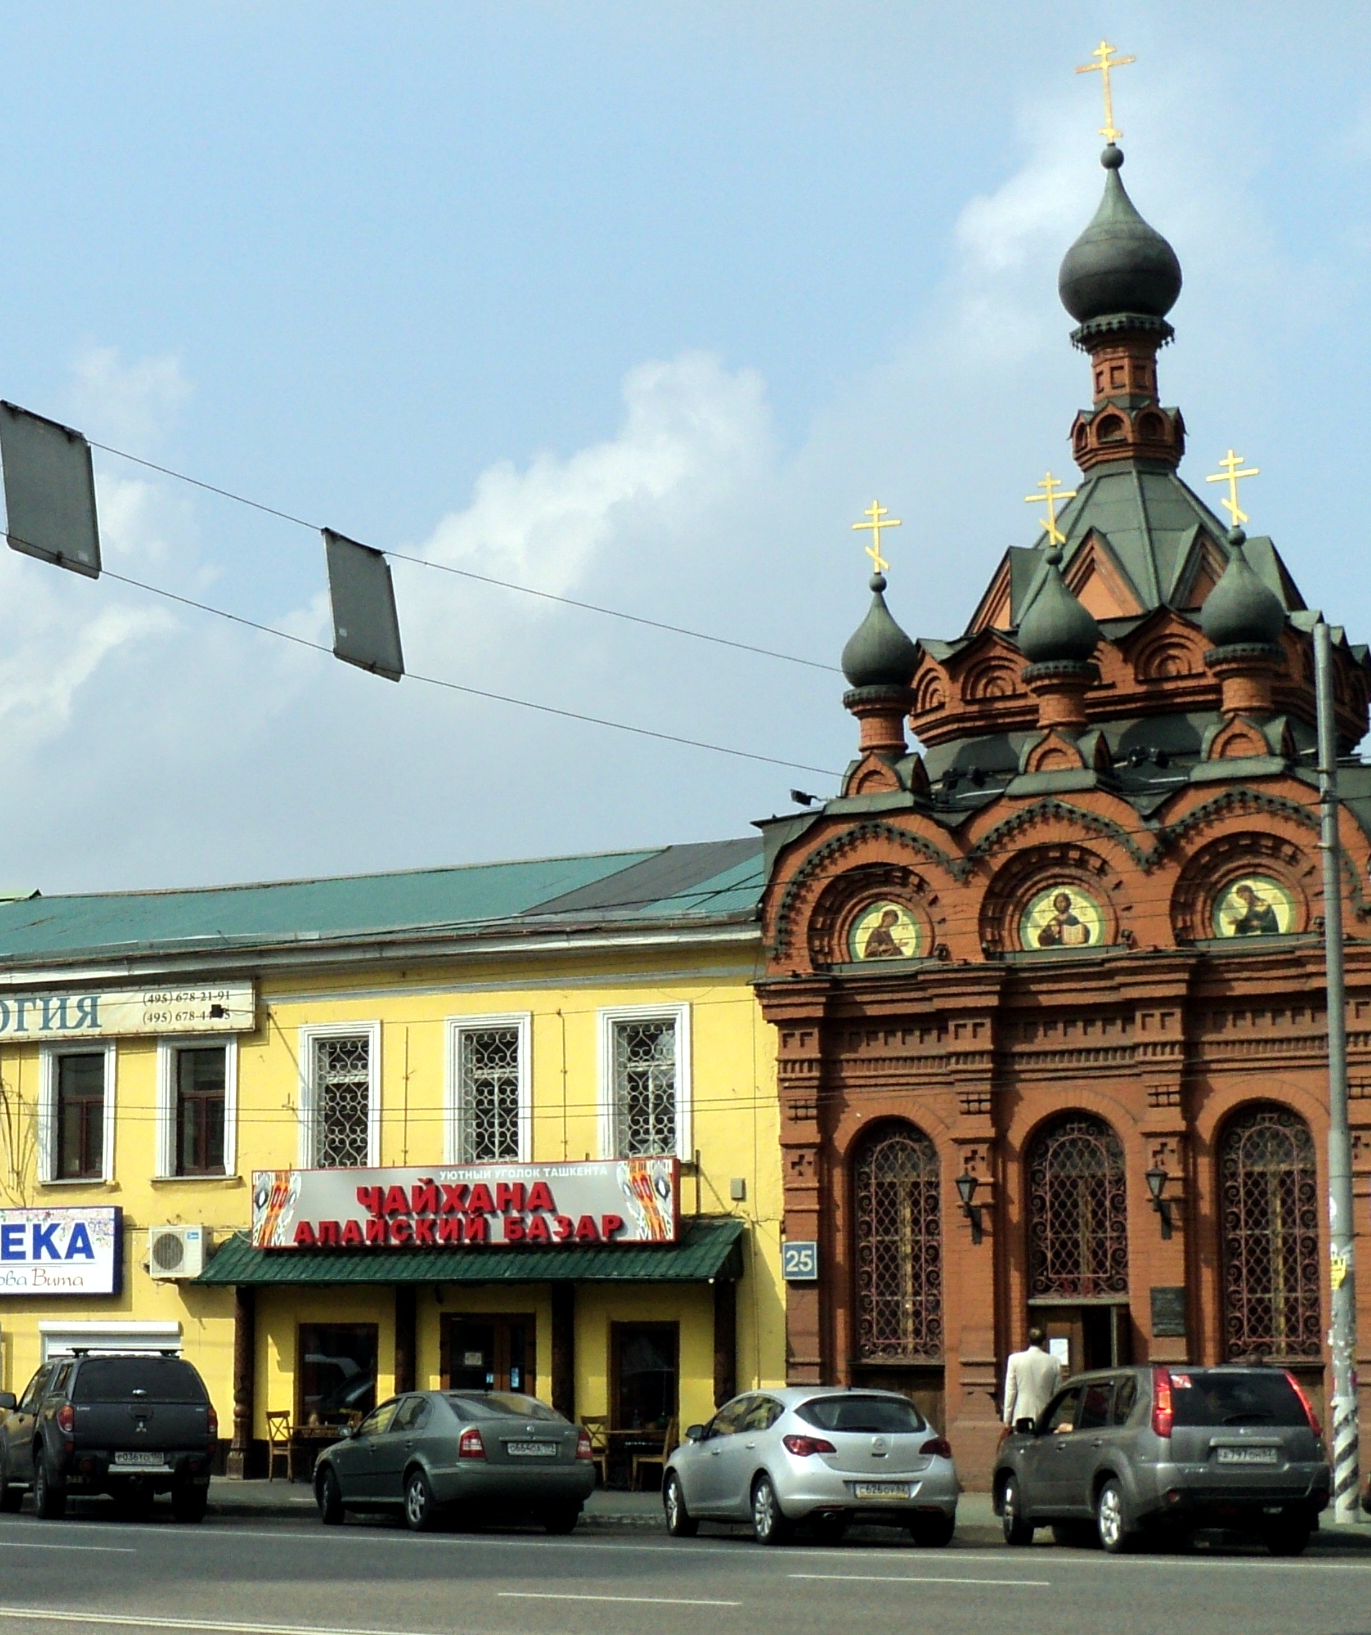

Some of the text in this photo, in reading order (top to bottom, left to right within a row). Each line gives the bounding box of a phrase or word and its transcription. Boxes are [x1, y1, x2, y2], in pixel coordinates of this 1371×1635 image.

[143, 991, 230, 1006] (495) 678-21-91
[143, 1010, 173, 1024] (495)
[495, 1168, 541, 1179] УГОЛОК
[543, 1166, 608, 1177] ТАШКЕНТА
[356, 1177, 556, 1216] ЧАЙХАНА
[293, 1211, 625, 1244] АЛАЙСКИЙ БАЗАР
[786, 1250, 813, 1272] 25
[31, 1267, 84, 1287] Вита
